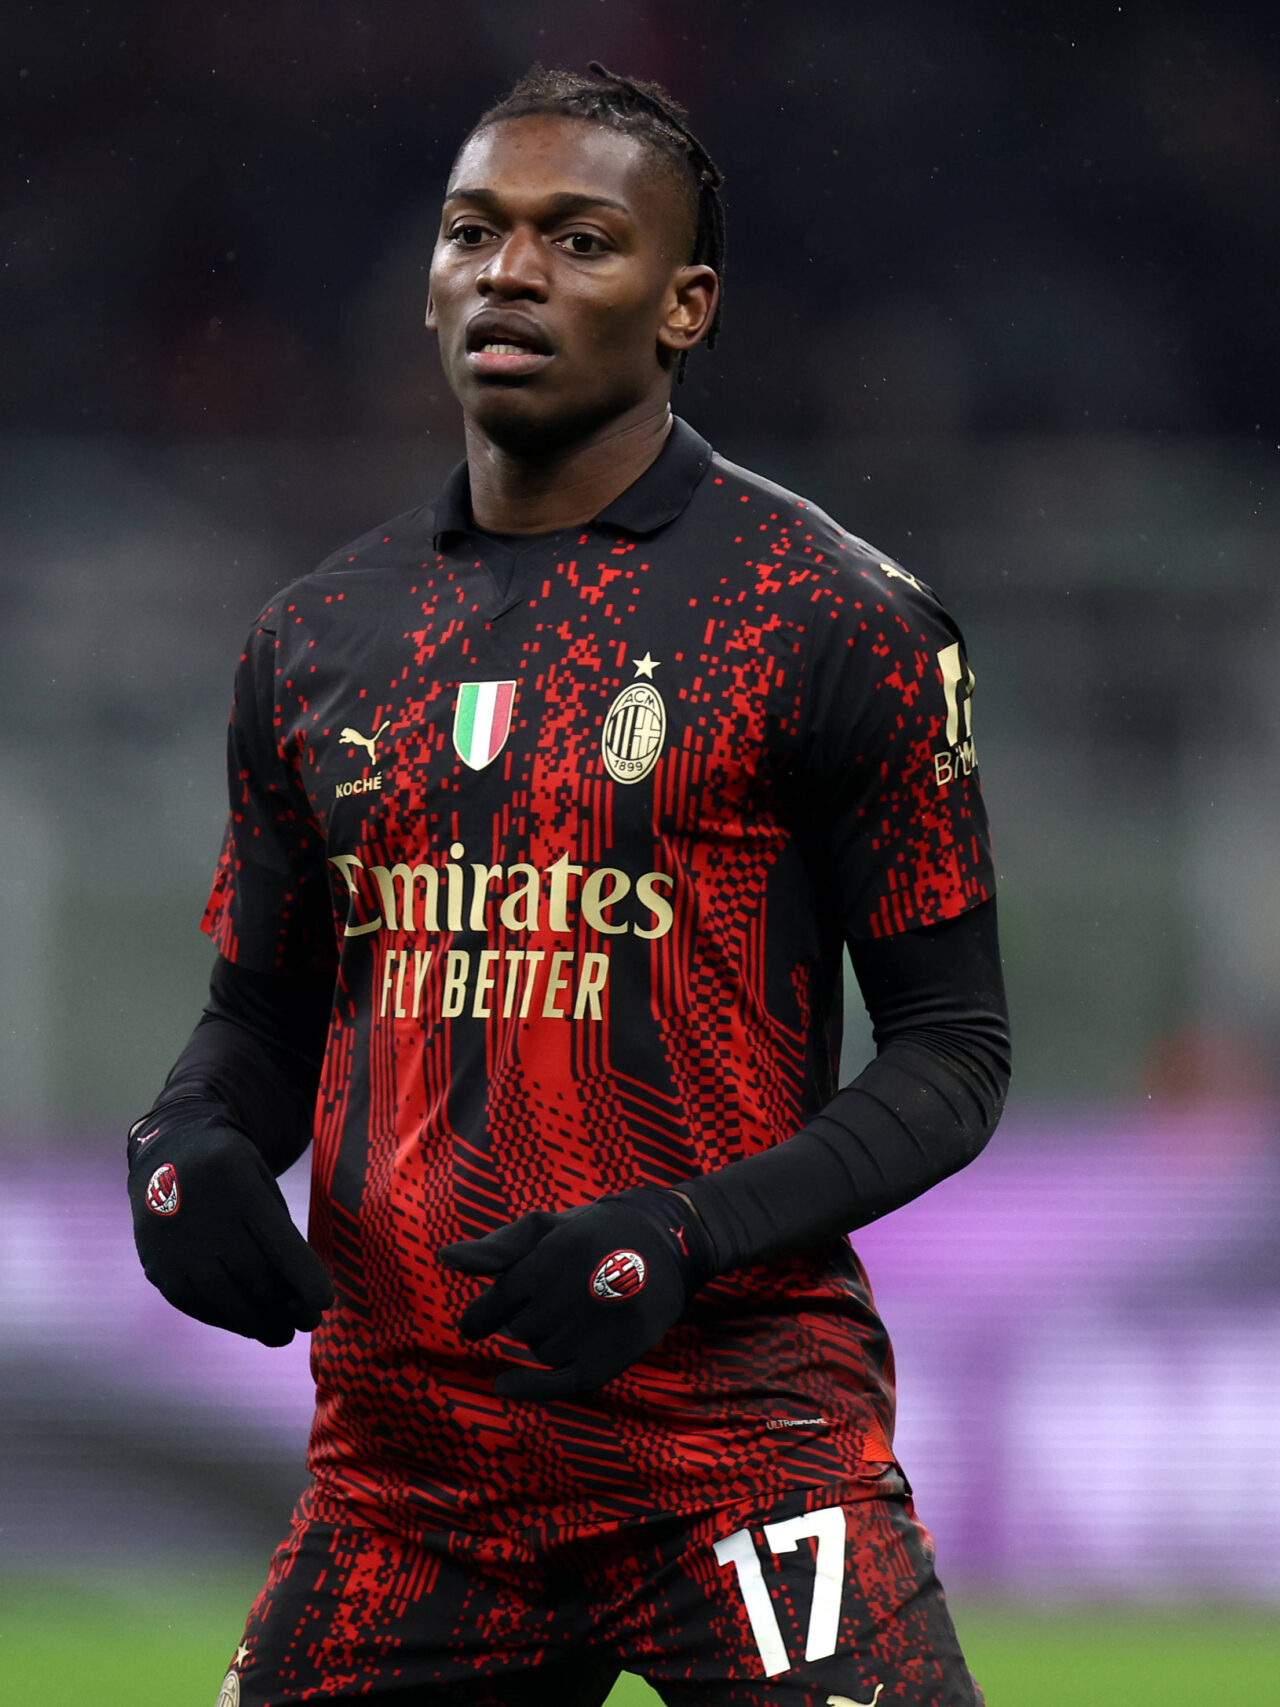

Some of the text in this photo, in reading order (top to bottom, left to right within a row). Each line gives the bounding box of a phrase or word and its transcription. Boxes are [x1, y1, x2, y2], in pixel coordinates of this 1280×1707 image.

[621, 690, 656, 710] ACM
[614, 760, 644, 772] 1899
[934, 736, 979, 786] BitM
[335, 771, 382, 798] KOCHÉ
[327, 842, 674, 939] Emirates
[380, 950, 610, 1020] FLY BETTER
[595, 1271, 615, 1297] ACM
[712, 1506, 846, 1678] 17
